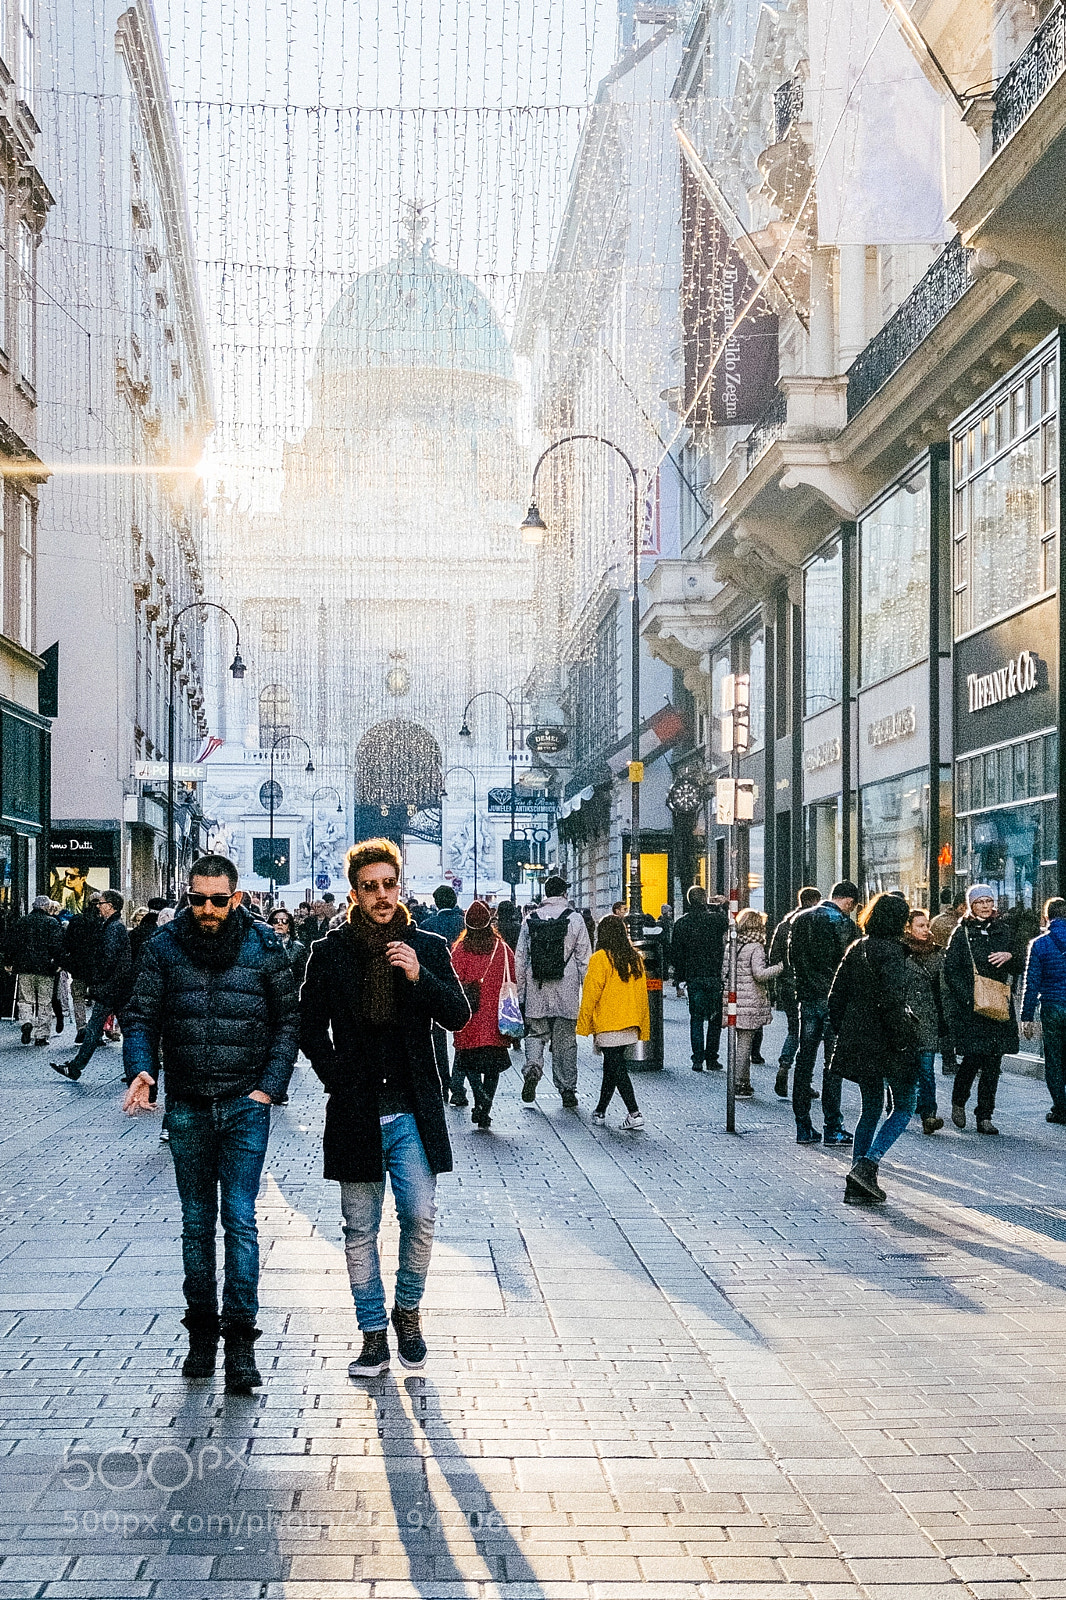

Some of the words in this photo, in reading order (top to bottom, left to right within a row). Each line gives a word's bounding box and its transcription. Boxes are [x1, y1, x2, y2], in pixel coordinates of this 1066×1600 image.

[722, 373, 741, 419] Zegna
[534, 734, 560, 743] DEMEL
[138, 763, 204, 778] APOHEKE
[70, 839, 94, 850] Dutti
